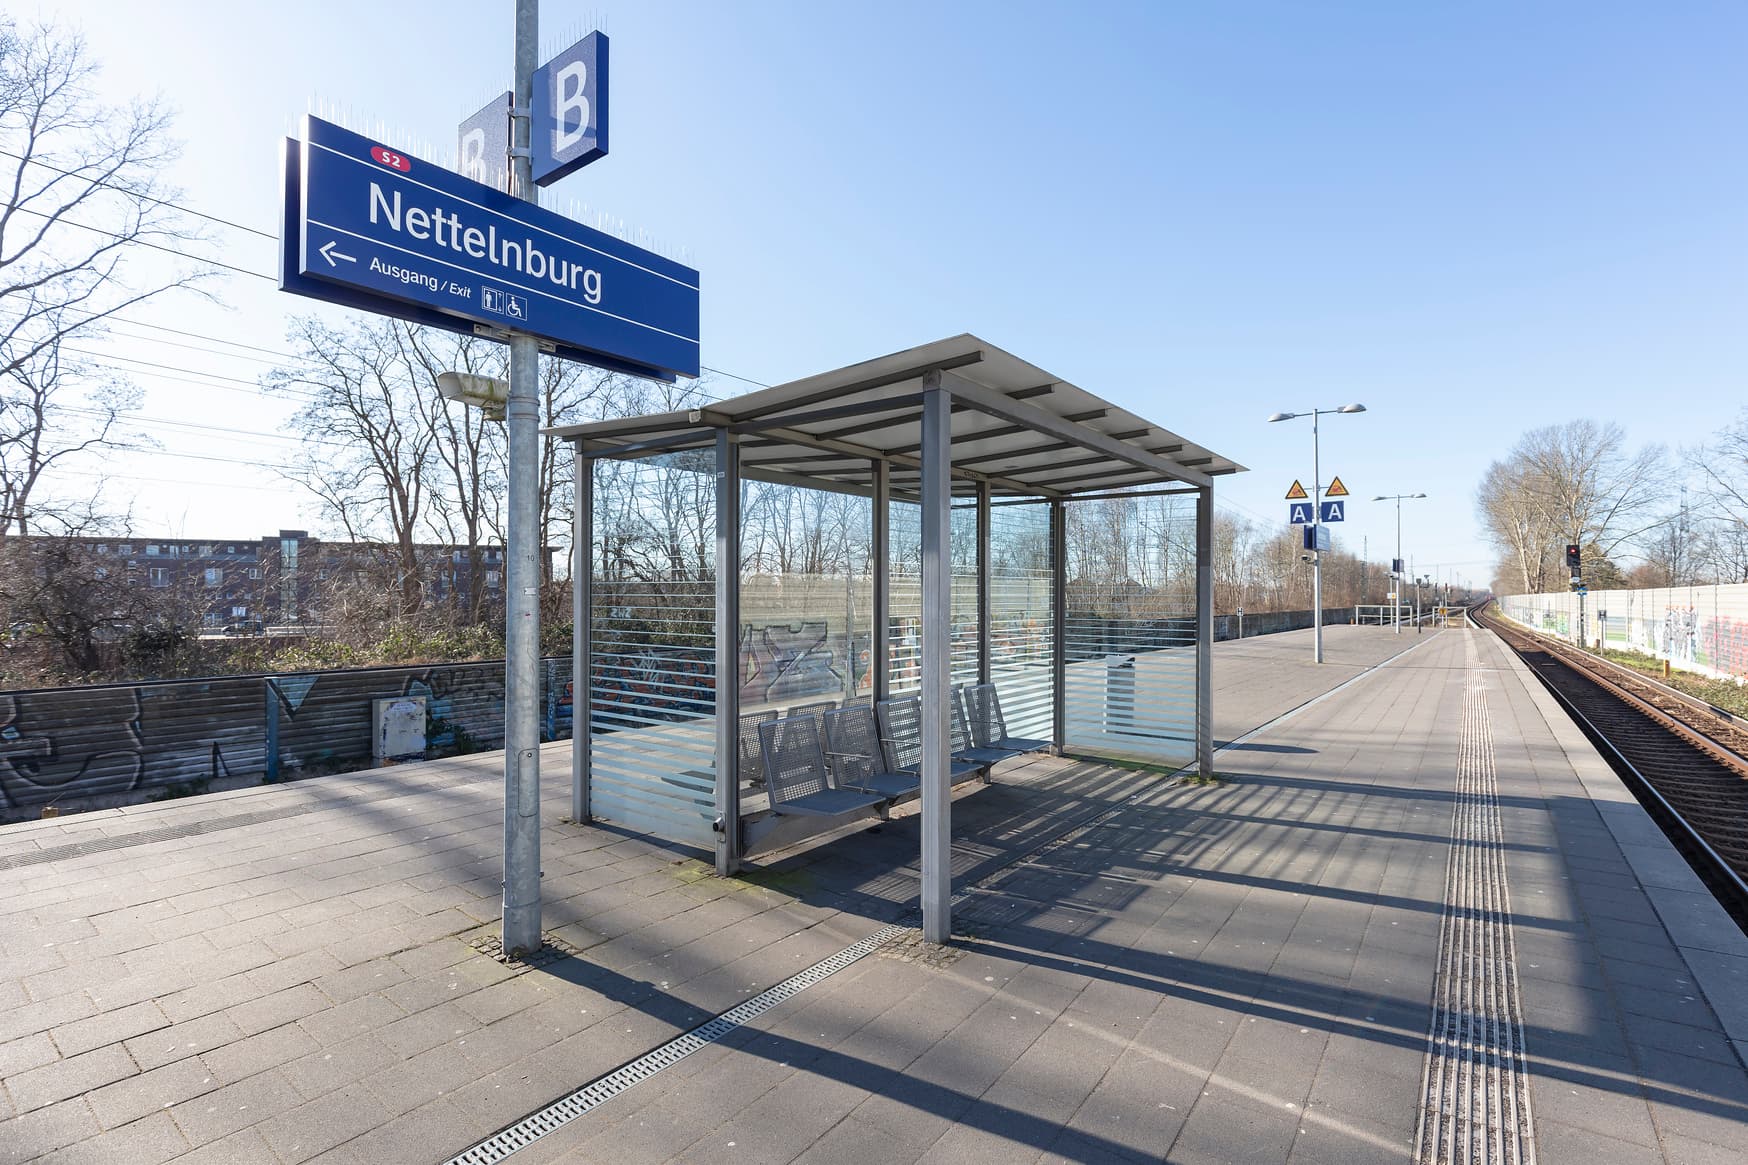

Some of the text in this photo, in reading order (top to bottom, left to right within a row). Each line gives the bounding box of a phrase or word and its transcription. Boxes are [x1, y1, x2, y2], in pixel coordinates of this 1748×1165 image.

[557, 61, 590, 153] B
[369, 182, 603, 305] Nettelnburg
[369, 257, 438, 292] Ausgang
[449, 282, 472, 299] Exit
[1292, 505, 1306, 522] A
[1327, 503, 1342, 520] A
